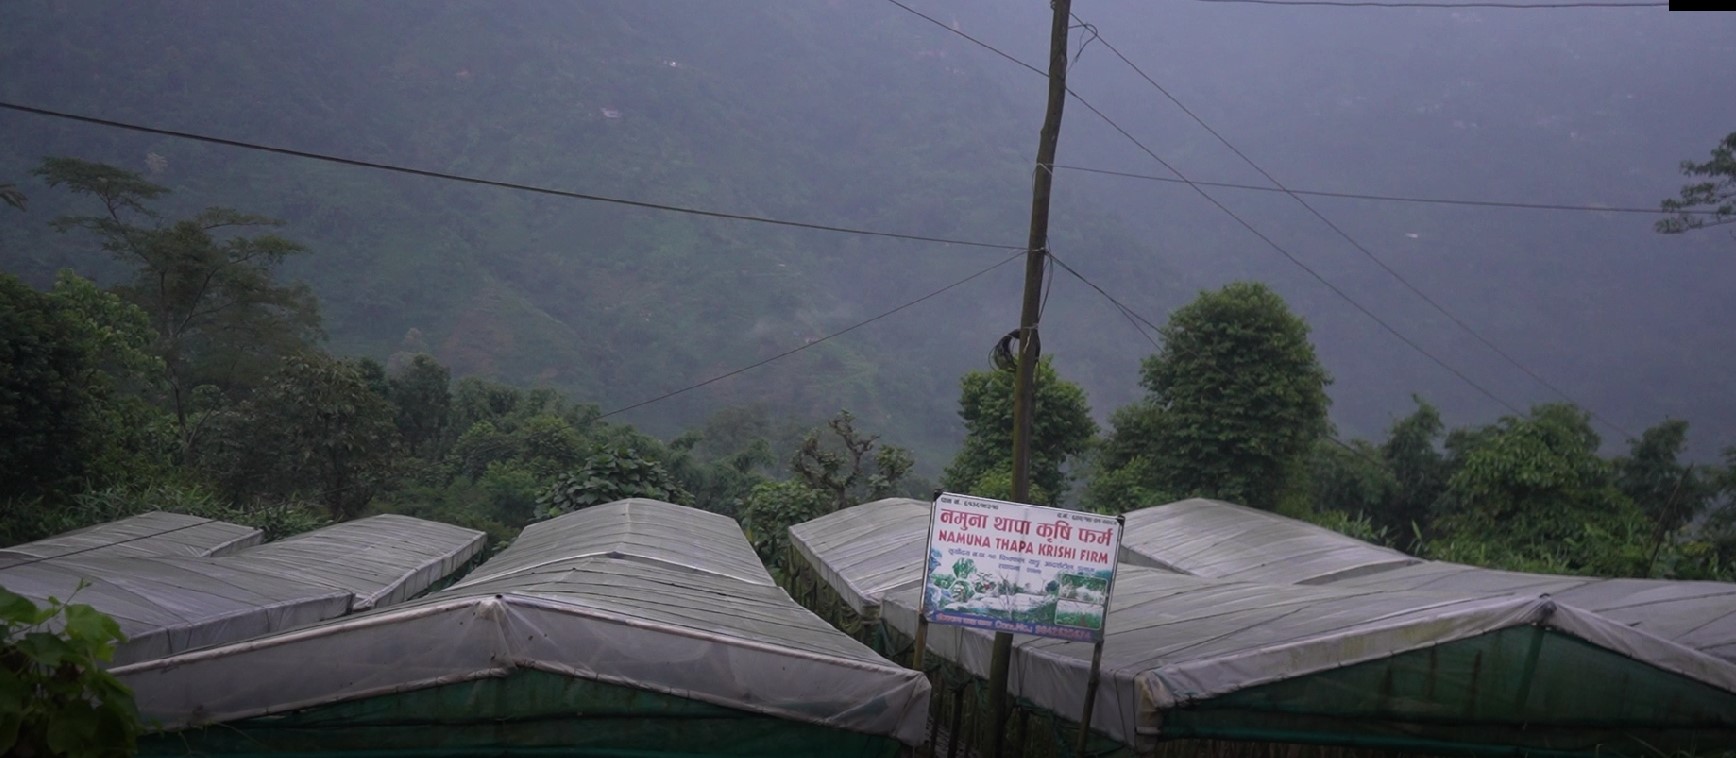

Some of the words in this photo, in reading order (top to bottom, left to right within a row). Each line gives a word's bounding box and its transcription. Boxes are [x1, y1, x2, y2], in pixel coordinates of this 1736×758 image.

[940, 508, 989, 531] नमुना
[993, 516, 1032, 535] थापा
[1036, 520, 1073, 542] कृषि
[1078, 527, 1114, 546] फर्म
[938, 530, 991, 548] NAMUNA
[996, 538, 1034, 553] THAPA
[1039, 543, 1076, 559] KRISHI
[1080, 550, 1109, 564] FIRM
